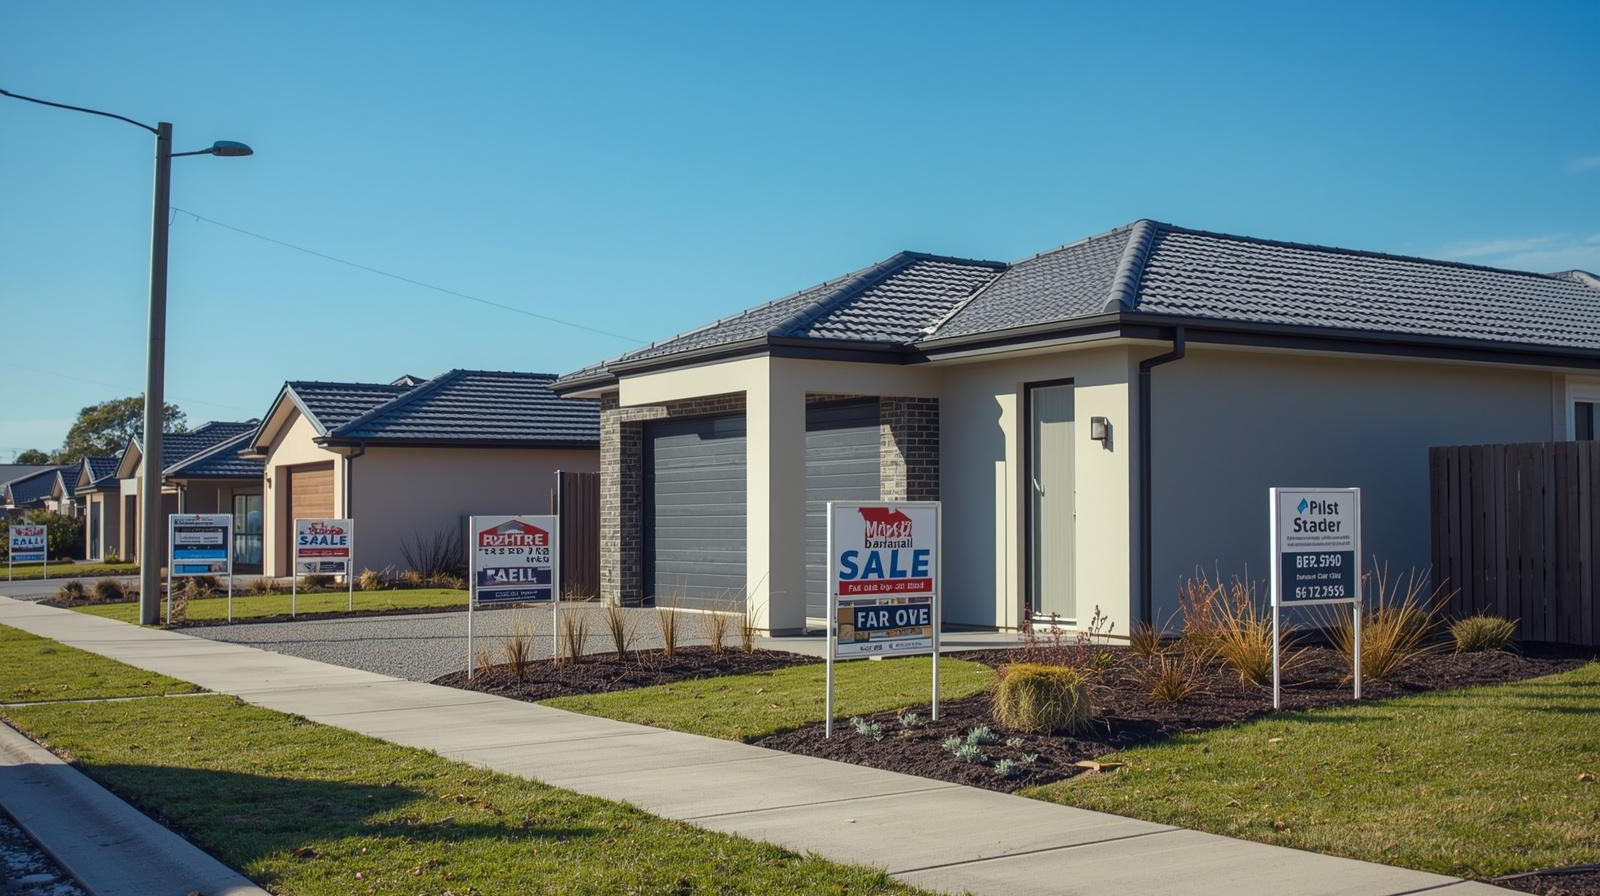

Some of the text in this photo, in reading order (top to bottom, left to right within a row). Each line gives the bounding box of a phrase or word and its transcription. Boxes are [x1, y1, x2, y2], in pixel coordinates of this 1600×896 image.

[1293, 517, 1341, 532] Stader
[839, 549, 930, 580] SALE
[857, 611, 890, 628] FAR
